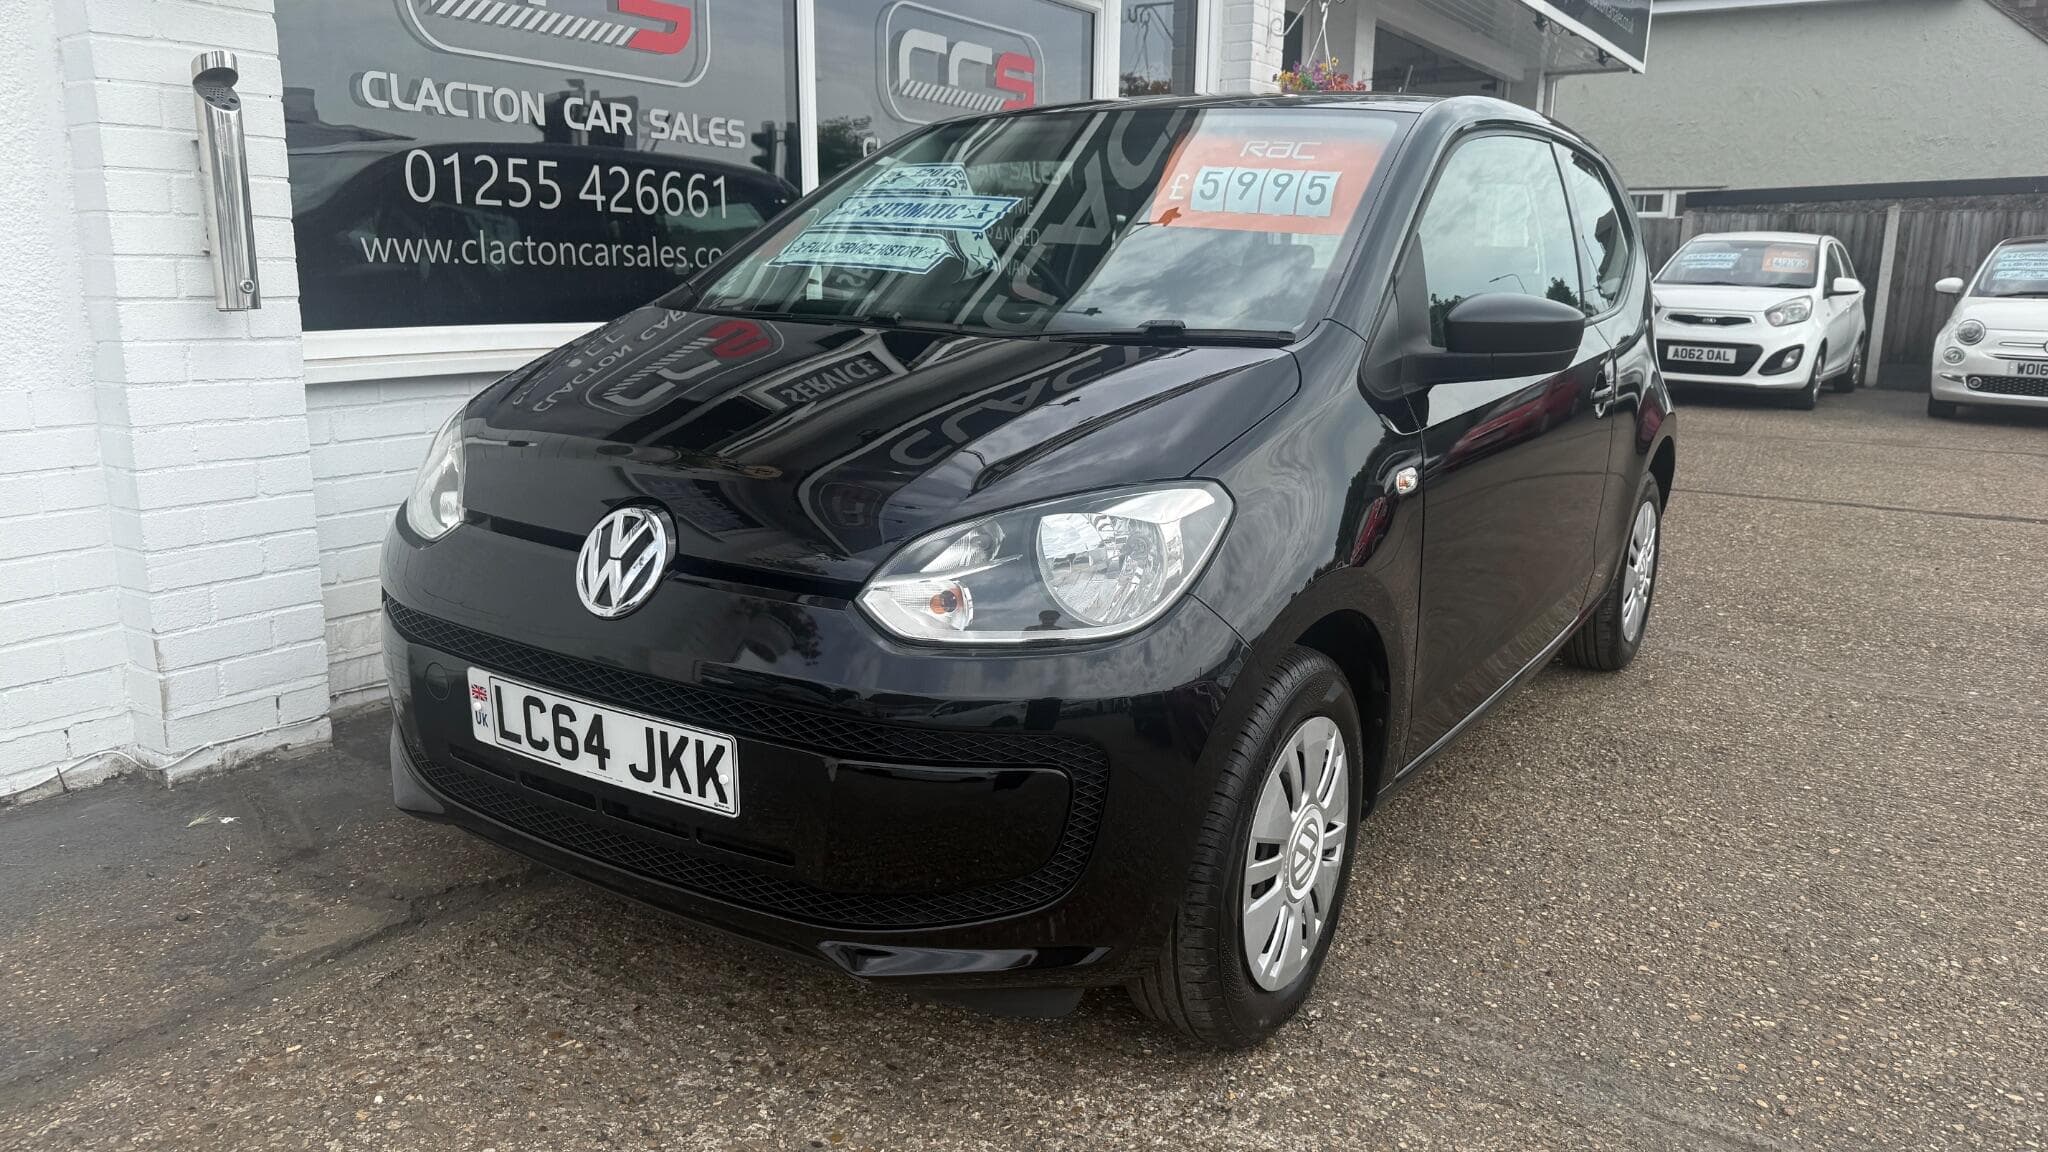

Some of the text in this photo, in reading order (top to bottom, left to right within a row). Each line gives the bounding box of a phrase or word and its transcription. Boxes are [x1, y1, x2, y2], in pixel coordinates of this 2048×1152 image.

[361, 70, 746, 149] CLACTON CAR SALES
[404, 148, 728, 219] 01255 426661
[1199, 171, 1331, 206] 5995
[860, 202, 967, 219] AUTOMATIC
[831, 242, 876, 256] SERVICE
[877, 244, 929, 259] HISTORY
[1706, 349, 1730, 362] OAL
[474, 710, 489, 728] UK
[494, 685, 728, 805] LC64 JKK
